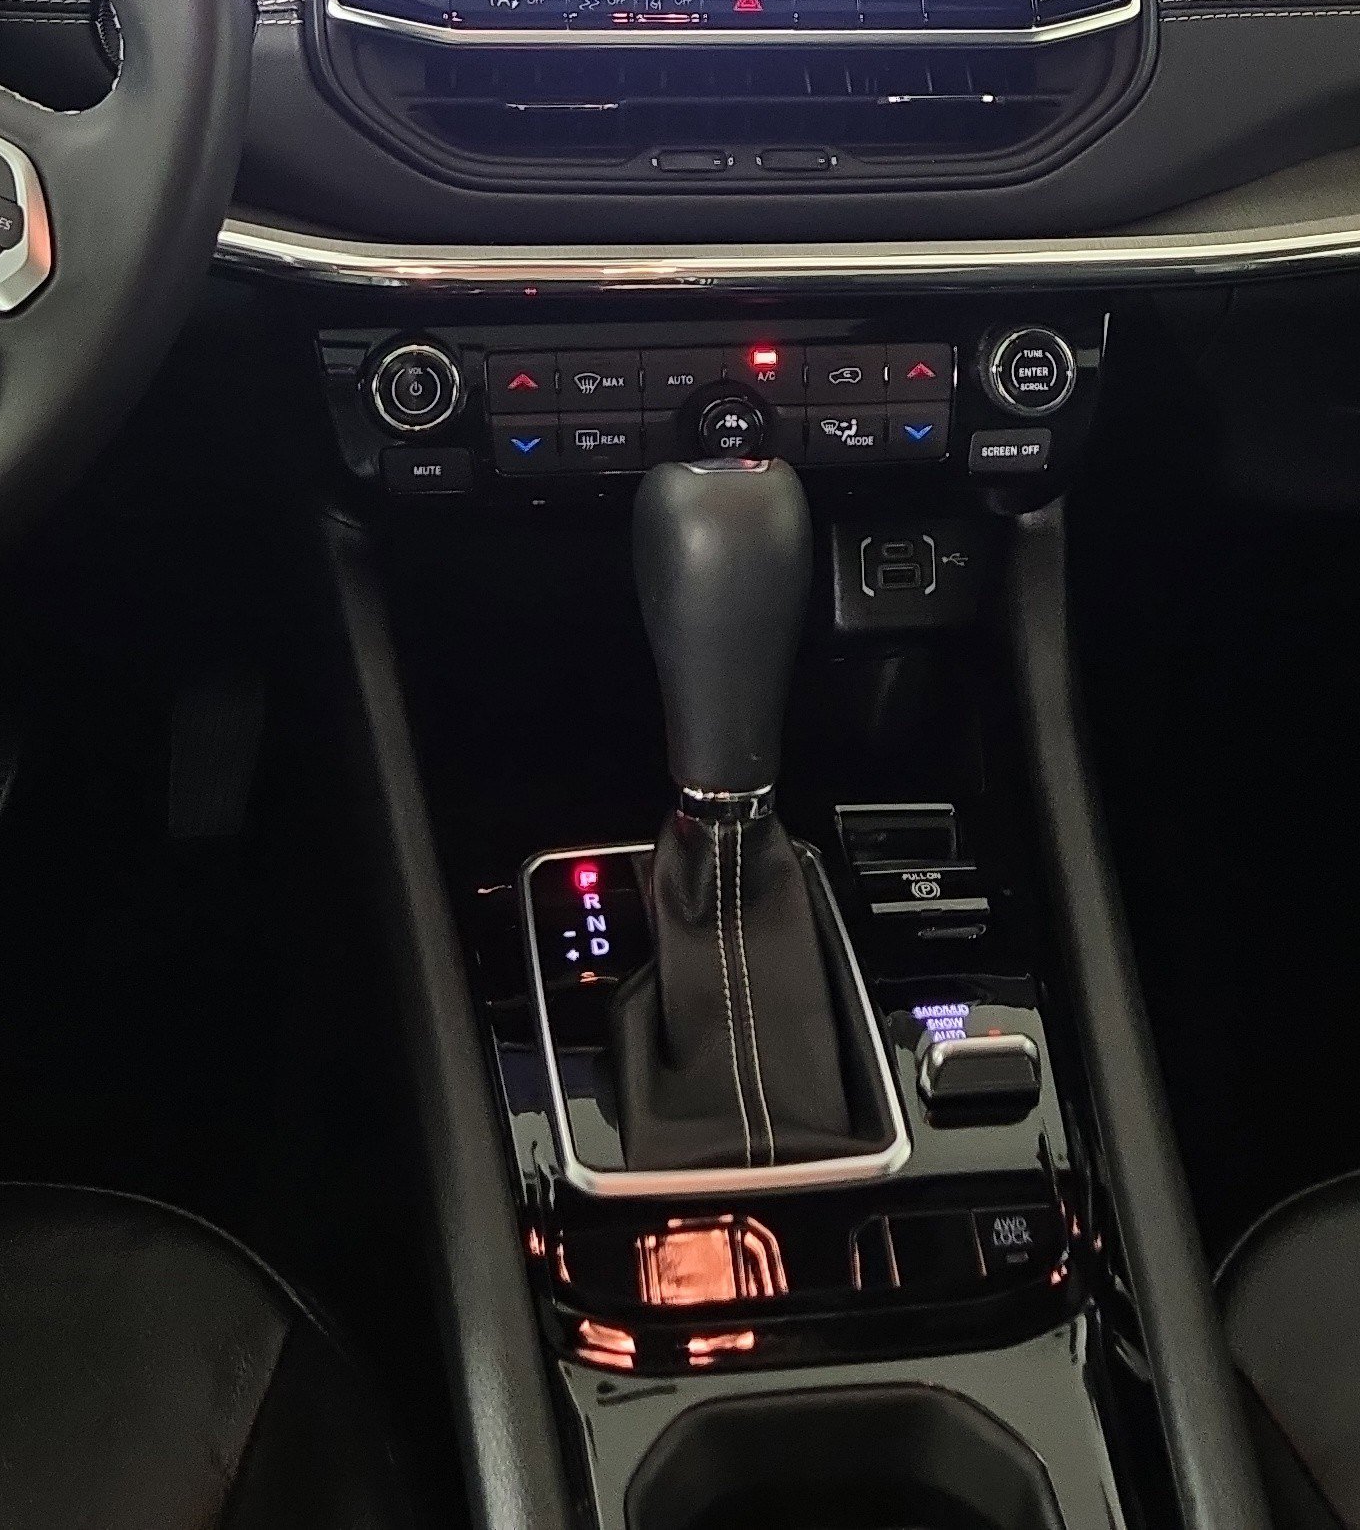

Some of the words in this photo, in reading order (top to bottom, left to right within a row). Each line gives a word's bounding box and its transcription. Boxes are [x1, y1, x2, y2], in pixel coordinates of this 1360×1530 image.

[1023, 349, 1044, 359] TUNE
[757, 371, 776, 382] A/C
[1018, 367, 1049, 377] ENTER
[602, 377, 624, 387] MAX
[667, 375, 694, 385] AUTO
[1020, 382, 1049, 391] SCROLL
[601, 435, 626, 445] REAR
[720, 437, 743, 448] OFF
[847, 436, 874, 446] MODE
[981, 446, 1018, 457] SCREEN
[1021, 445, 1040, 455] OFF
[413, 466, 442, 476] MUTE
[580, 871, 597, 888] P
[583, 894, 601, 909] R
[586, 915, 606, 932] N
[591, 938, 610, 956] D
[927, 1018, 964, 1030] SNOW
[934, 1030, 966, 1042] AUTO
[994, 1217, 1027, 1231] 4WD
[992, 1230, 1033, 1246] LOCK
